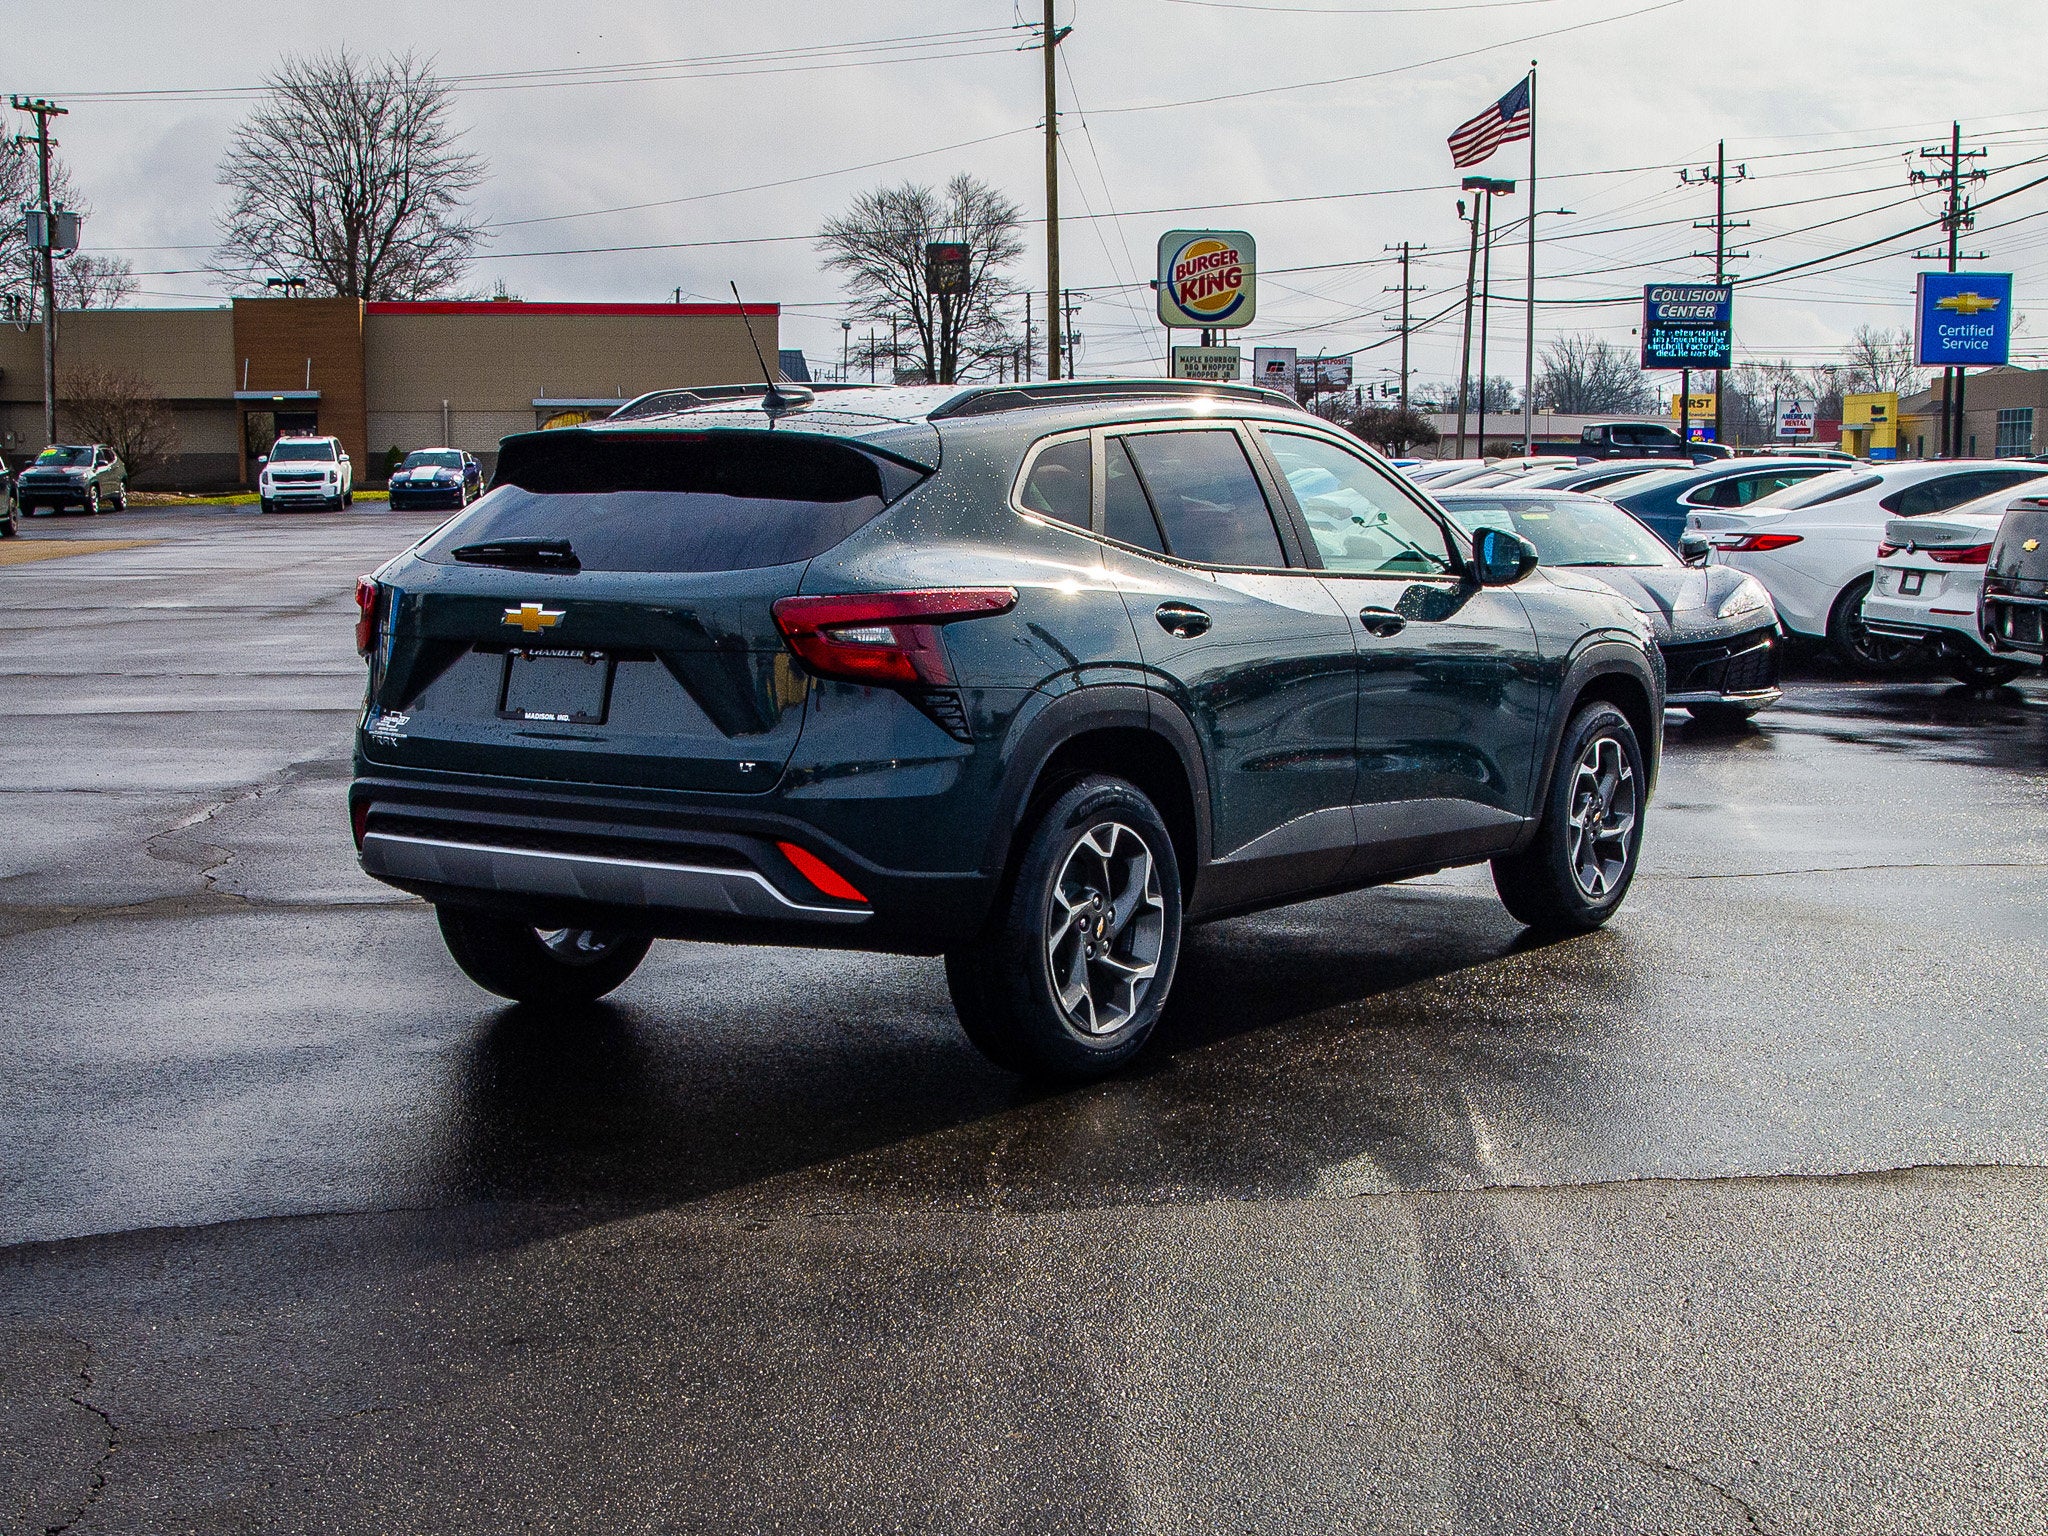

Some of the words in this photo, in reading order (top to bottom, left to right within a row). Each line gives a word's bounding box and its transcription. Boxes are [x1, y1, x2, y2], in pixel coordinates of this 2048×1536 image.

[1176, 250, 1239, 281] BURGER
[1181, 267, 1242, 305] KING
[1651, 288, 1726, 302] COLLISION
[1659, 304, 1715, 317] CENTER
[1938, 325, 1994, 337] Certified
[1942, 338, 1989, 350] Service
[1184, 363, 1199, 371] BBQ
[1202, 363, 1235, 371] WHOPPER
[529, 649, 584, 657] CHANDLER
[740, 763, 756, 773] LT
